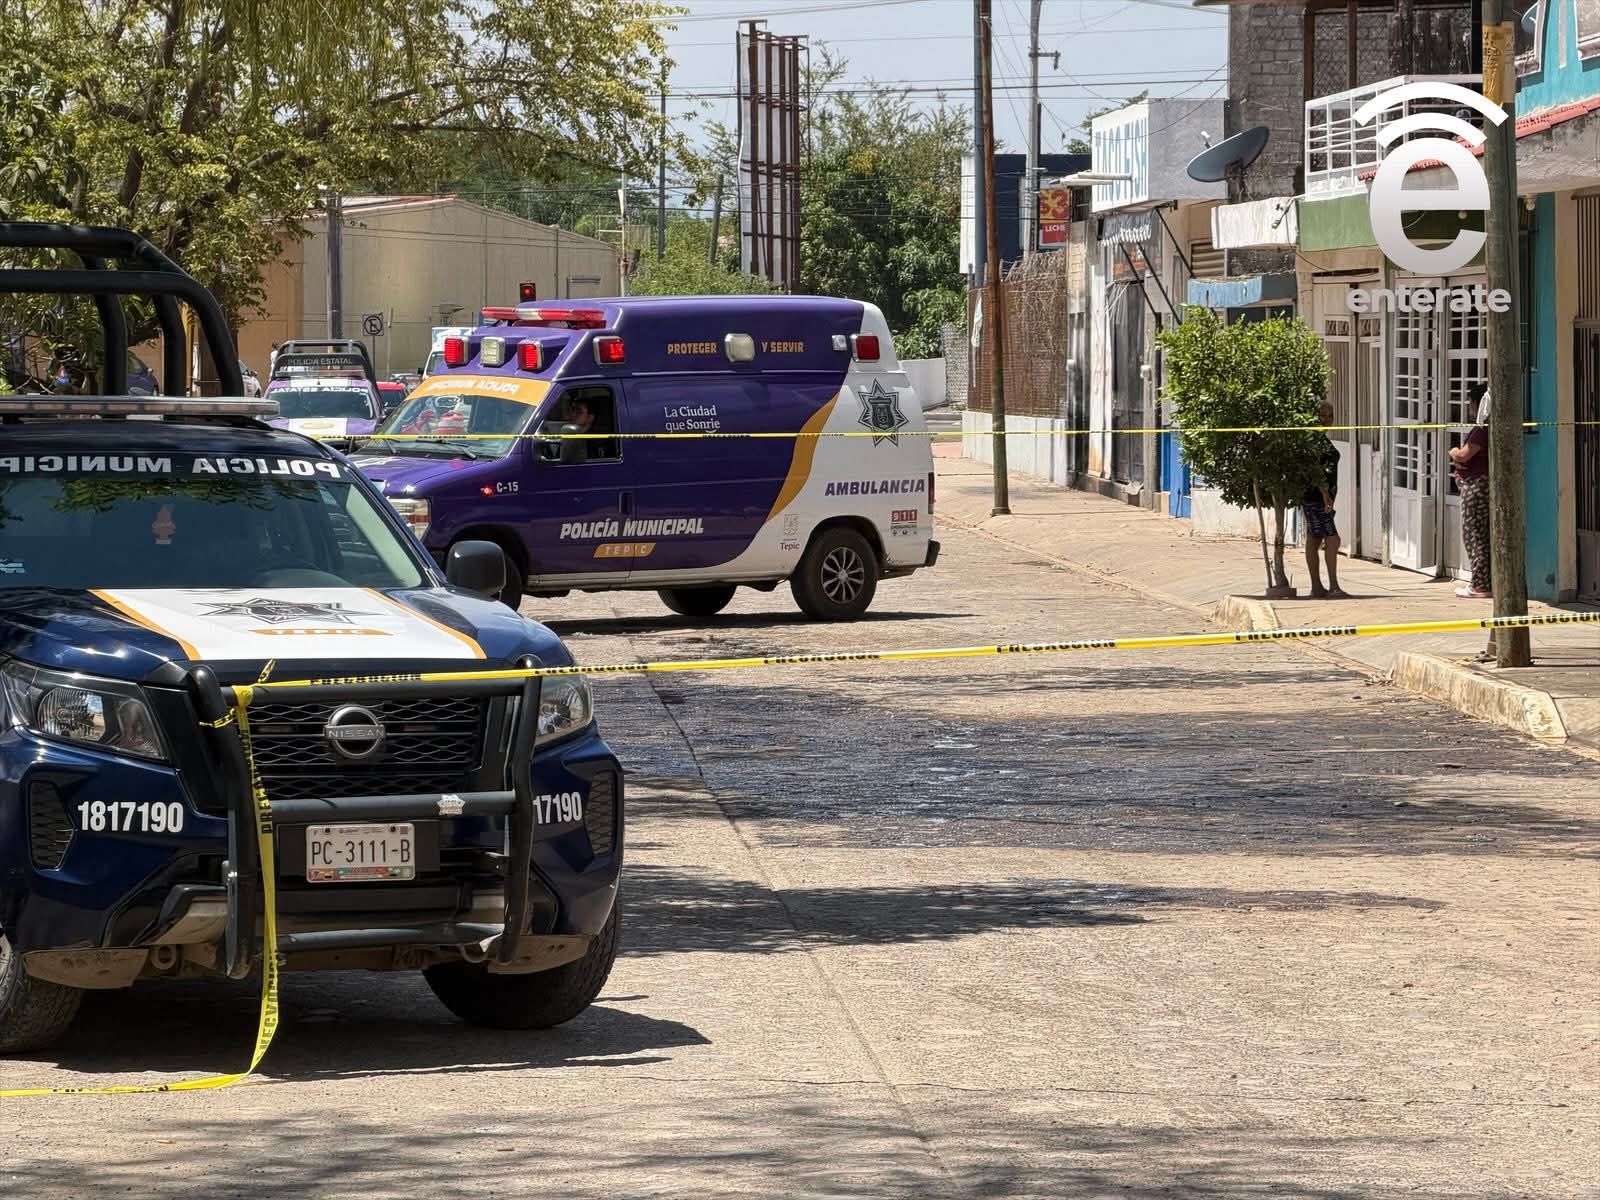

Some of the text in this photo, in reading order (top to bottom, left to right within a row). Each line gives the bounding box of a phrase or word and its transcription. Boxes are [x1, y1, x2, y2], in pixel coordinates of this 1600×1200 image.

[667, 341, 804, 354] PROTEGER Y SERVIR
[664, 405, 717, 417] La Ciudad
[665, 418, 721, 433] que Sonrie
[496, 481, 519, 493] C-15
[824, 479, 925, 496] AMBULANCIA
[893, 510, 916, 521] 911
[560, 517, 705, 539] POLICÍA MUNICIPAL
[605, 545, 647, 555] TEPIC
[780, 541, 800, 551] Tepic
[328, 728, 384, 738] NISSAN
[78, 800, 184, 833] 1817190
[311, 839, 411, 865] PC-3111-B
